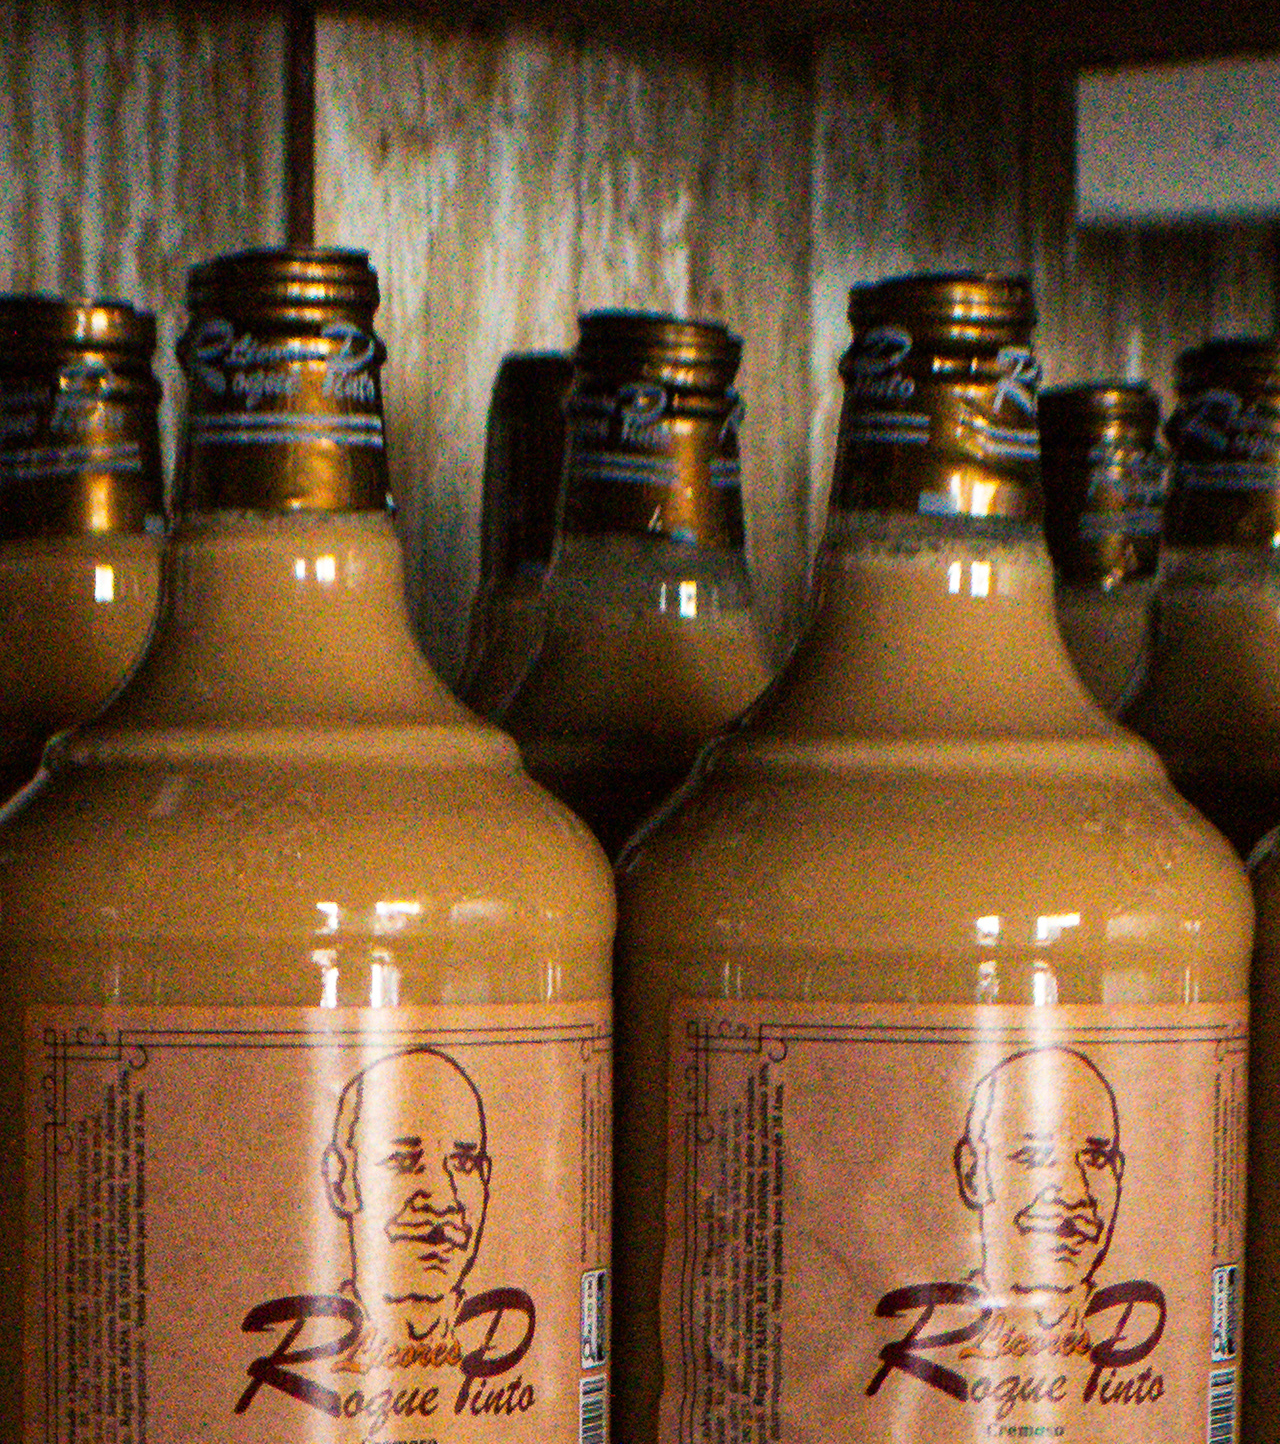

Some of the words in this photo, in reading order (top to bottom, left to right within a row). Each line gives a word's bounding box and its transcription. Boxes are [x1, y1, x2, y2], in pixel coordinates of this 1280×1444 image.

[233, 1293, 440, 1436] Roque
[453, 1286, 537, 1416] Pinto
[330, 1330, 462, 1374] Licores
[865, 1281, 1068, 1420] Roque
[1082, 1278, 1167, 1406] Pinto
